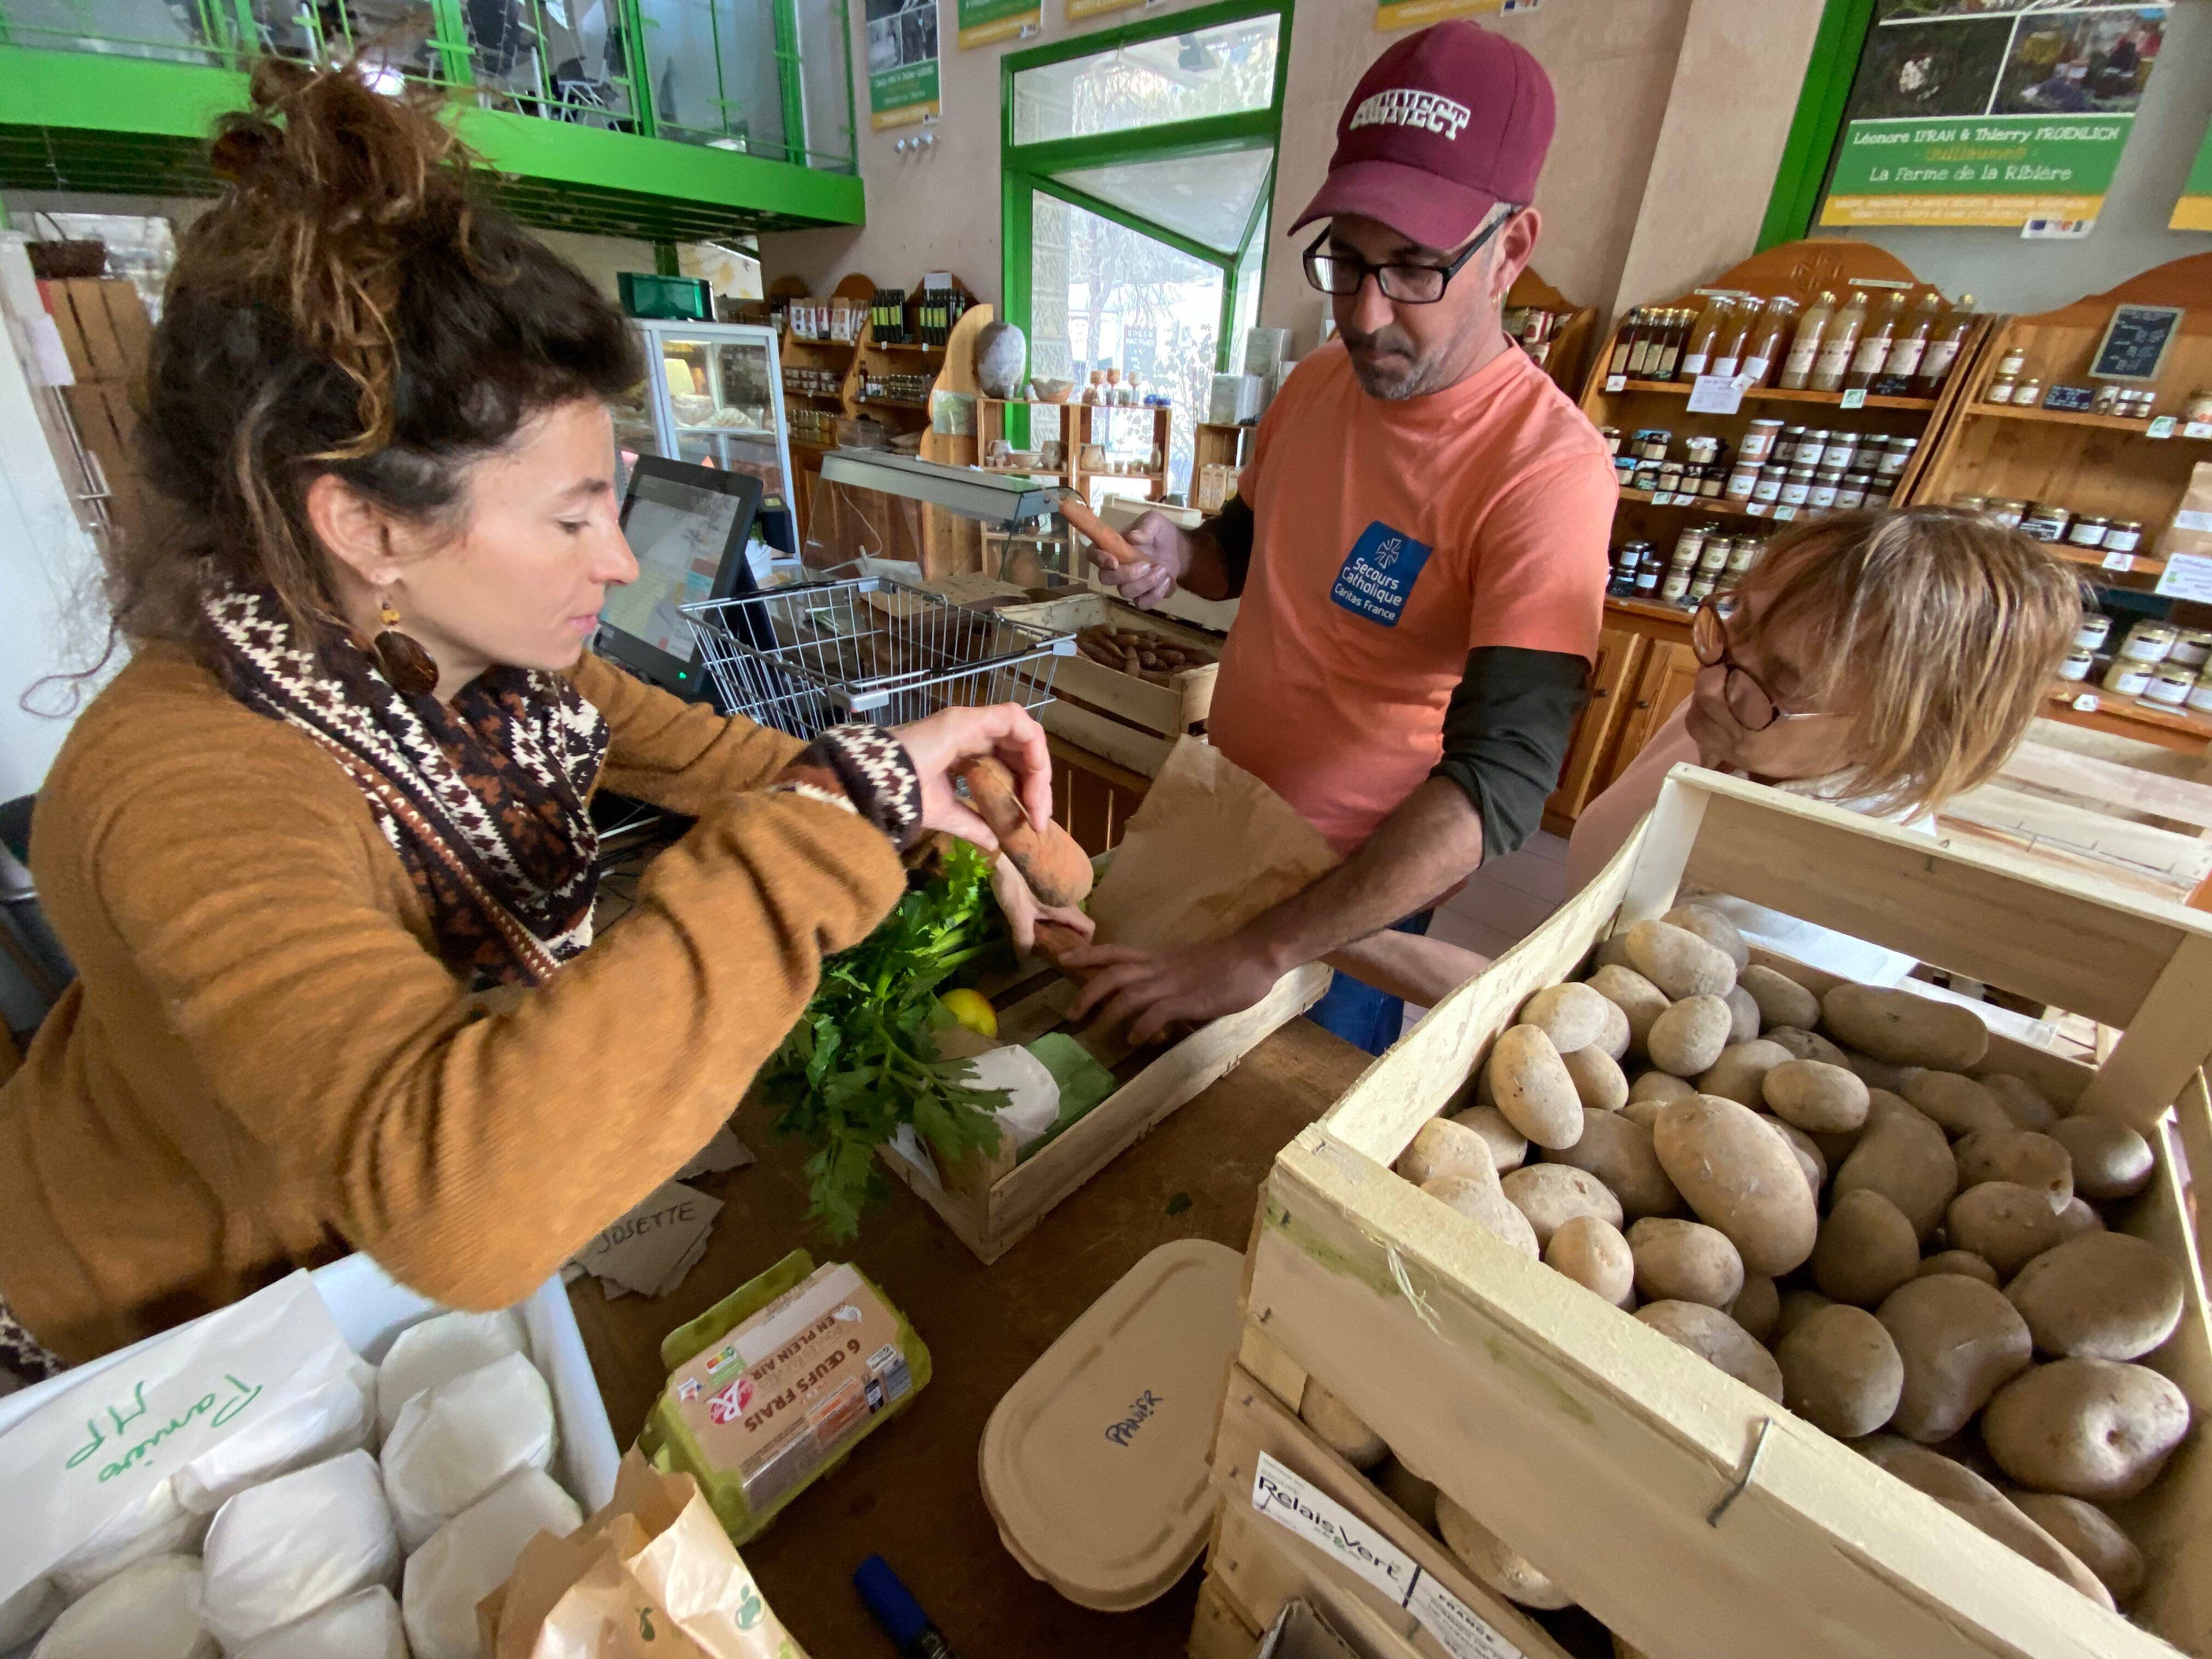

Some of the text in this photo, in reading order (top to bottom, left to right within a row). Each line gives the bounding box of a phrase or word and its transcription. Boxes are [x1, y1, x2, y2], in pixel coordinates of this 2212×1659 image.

[1869, 166, 1889, 182] La
[1954, 165, 1975, 180] de
[1342, 566, 1402, 607] Catholique
[1352, 557, 1400, 590] Secours
[1334, 583, 1362, 606] Caritas
[597, 1200, 696, 1254] JOSETTE
[816, 1316, 835, 1333] EN
[777, 1329, 816, 1363] PLEIN
[847, 1338, 861, 1355] 6
[751, 1358, 775, 1380] AIR
[744, 1387, 796, 1432] FRAIS
